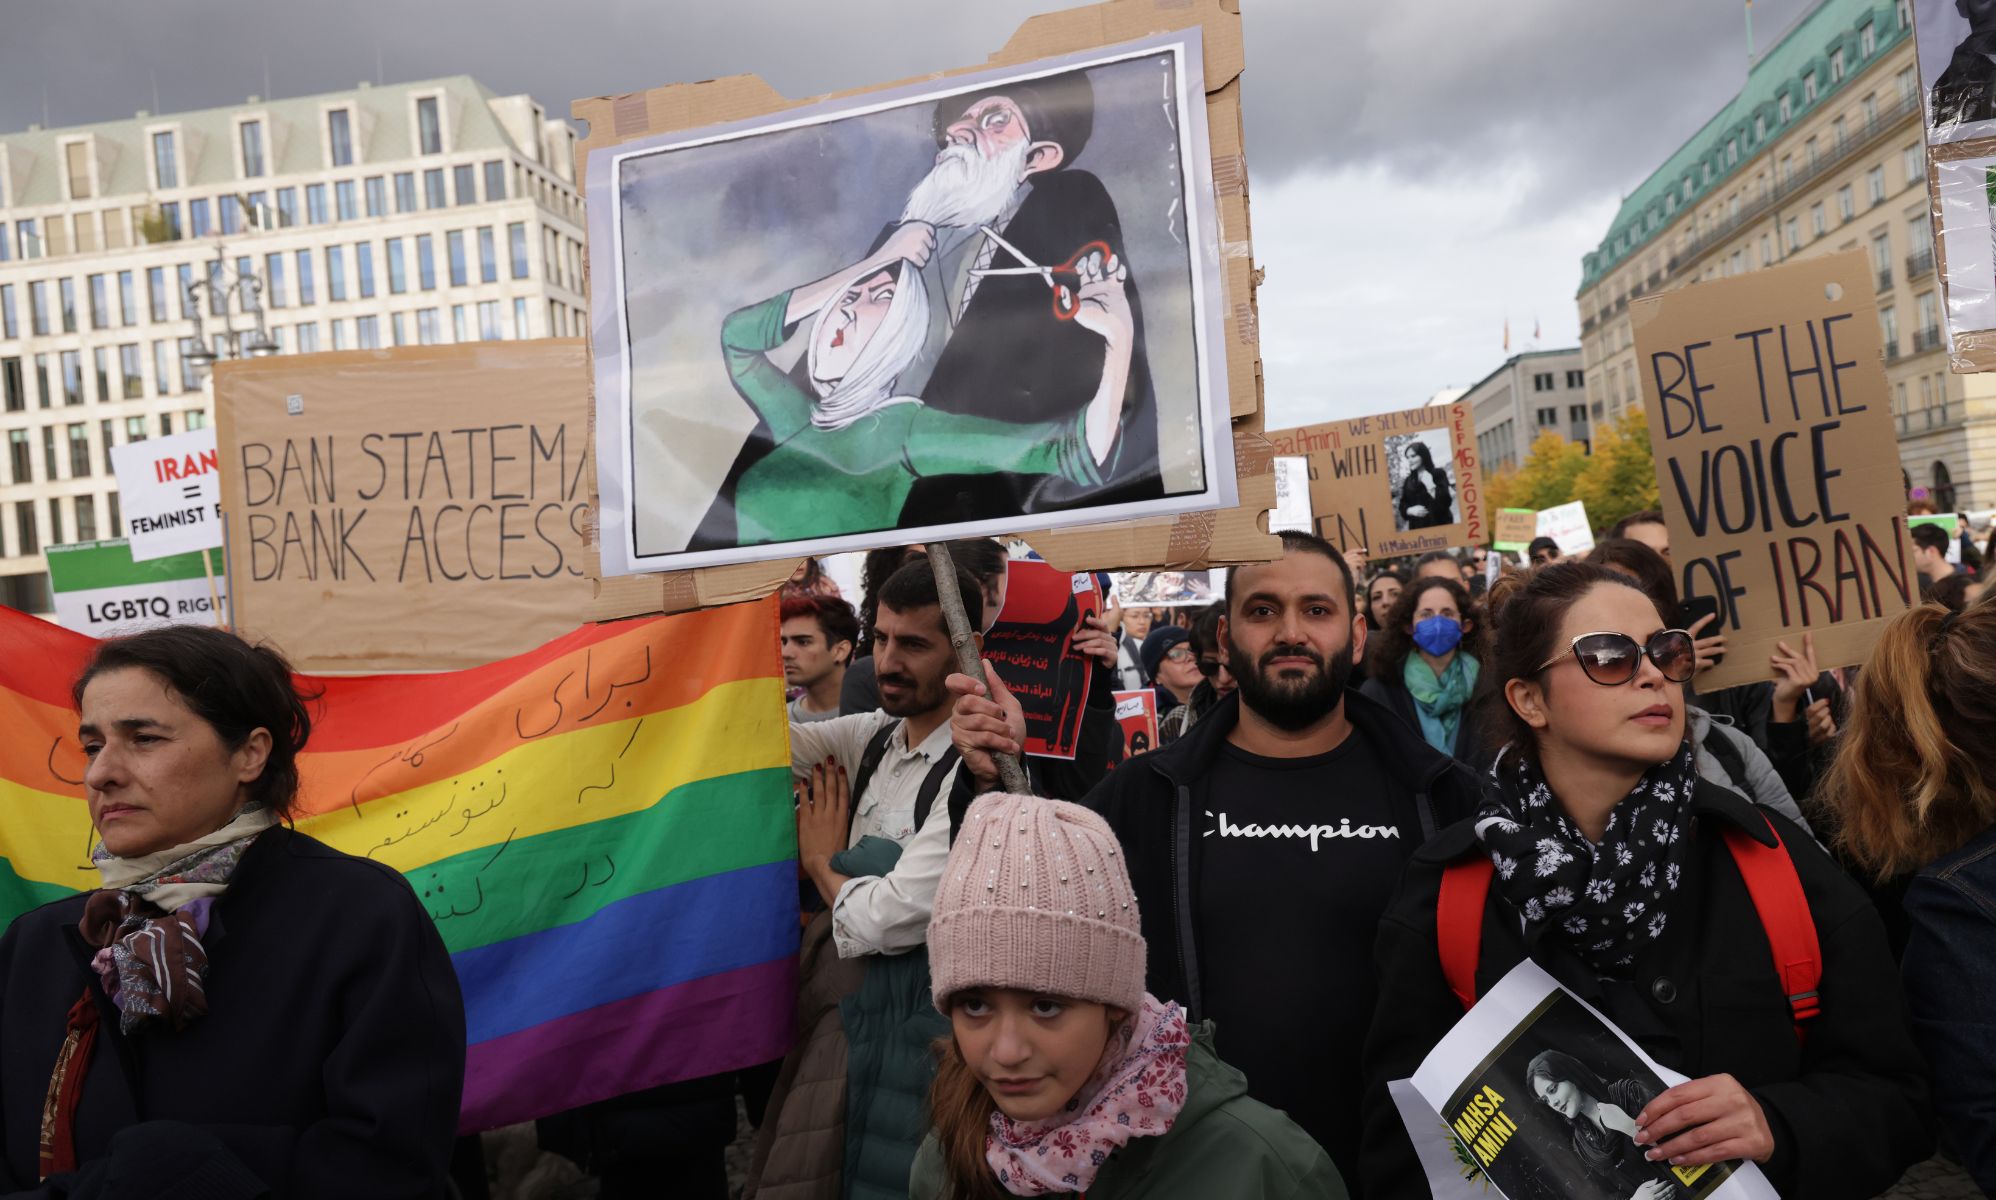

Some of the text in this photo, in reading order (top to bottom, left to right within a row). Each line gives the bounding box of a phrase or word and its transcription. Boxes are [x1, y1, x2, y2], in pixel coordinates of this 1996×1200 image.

[1651, 313, 1868, 439] BE THE
[1348, 416, 1370, 436] WE
[154, 448, 219, 484] IRAN
[242, 435, 335, 507] BAN
[1331, 443, 1378, 480] WITH
[1668, 421, 1850, 538] VOICE
[131, 507, 206, 535] FEMINIST
[248, 508, 376, 583] BANK
[1683, 515, 1912, 631] OF IRAN
[87, 596, 170, 623] LGBTQ
[516, 644, 651, 739] برای
[1202, 809, 1401, 852] hampion
[563, 854, 616, 901] در
[1453, 1084, 1506, 1145] MAHSA
[1472, 1110, 1518, 1168] AMINI
